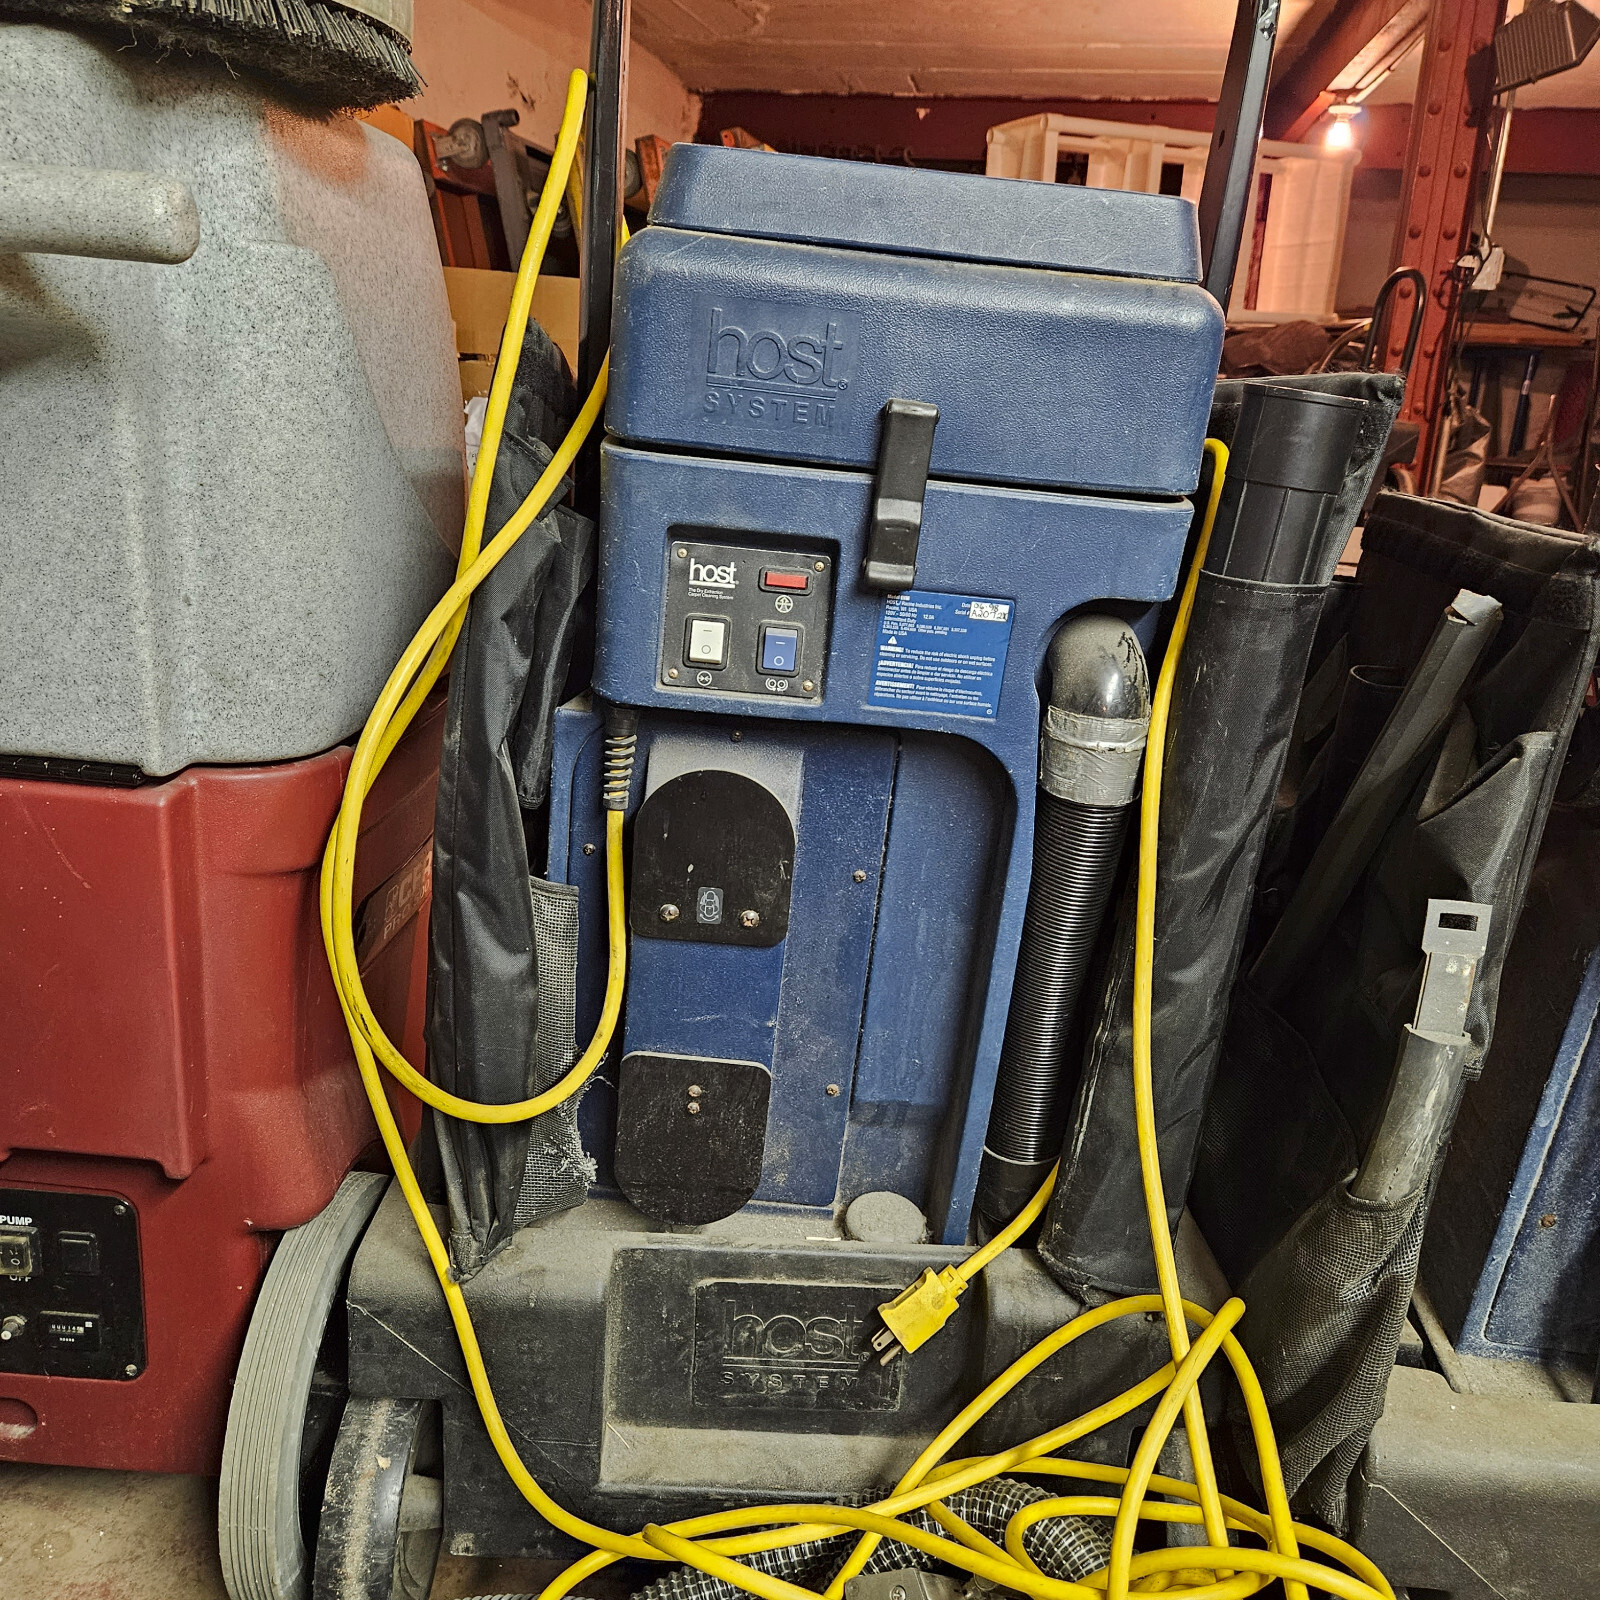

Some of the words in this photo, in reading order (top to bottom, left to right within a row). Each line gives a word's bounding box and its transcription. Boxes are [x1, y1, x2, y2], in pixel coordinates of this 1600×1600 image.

[707, 307, 843, 388] host
[702, 390, 836, 427] SYSTEM
[689, 557, 737, 584] host
[0, 1215, 32, 1225] PUMP
